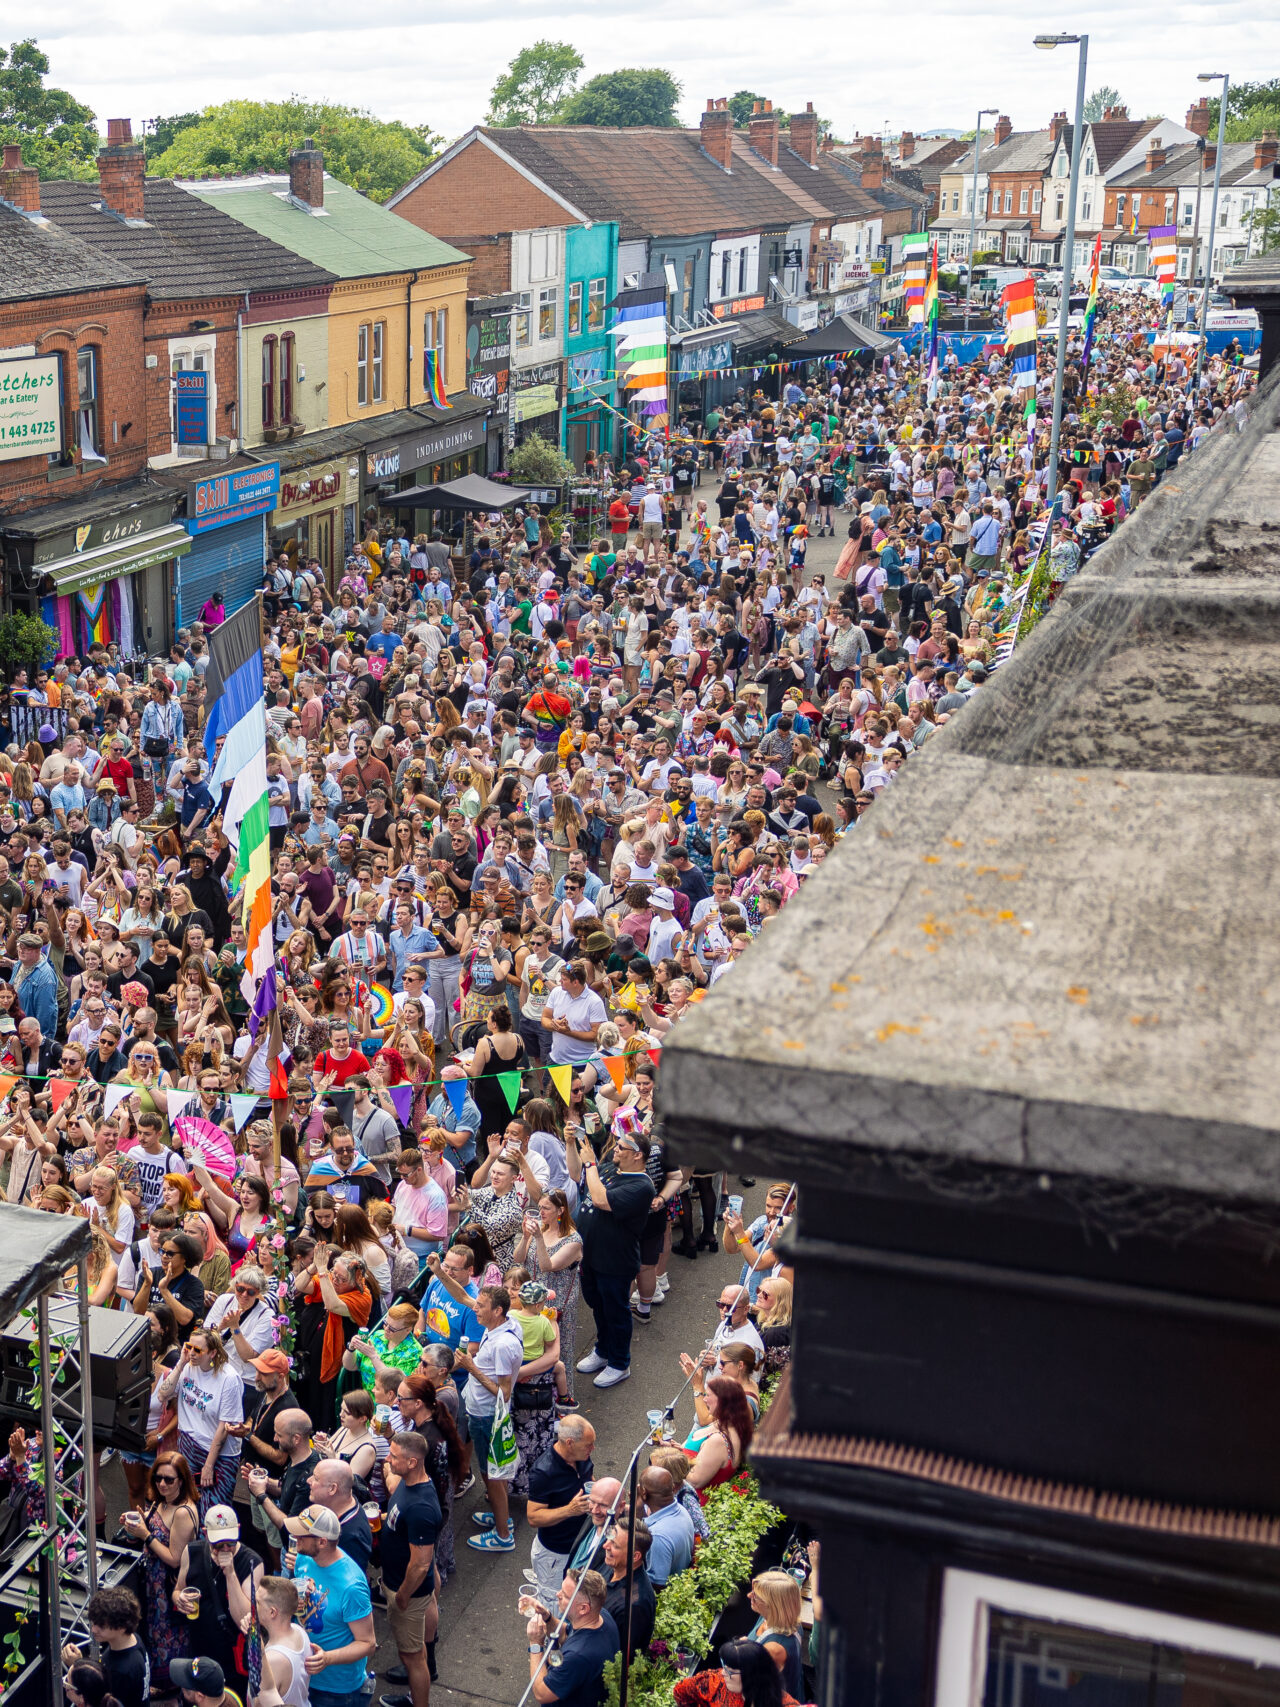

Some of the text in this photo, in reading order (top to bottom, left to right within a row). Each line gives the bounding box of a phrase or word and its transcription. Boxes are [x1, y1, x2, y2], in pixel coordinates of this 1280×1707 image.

[178, 376, 204, 388] Skill
[9, 395, 15, 404] &
[16, 394, 39, 404] Eatery
[8, 424, 28, 438] 443
[30, 420, 56, 435] 4725
[416, 430, 473, 459] INDIAN DINING
[233, 467, 276, 491] ELECTRONICS
[196, 477, 229, 514] Skill
[138, 1162, 164, 1180] STOP
